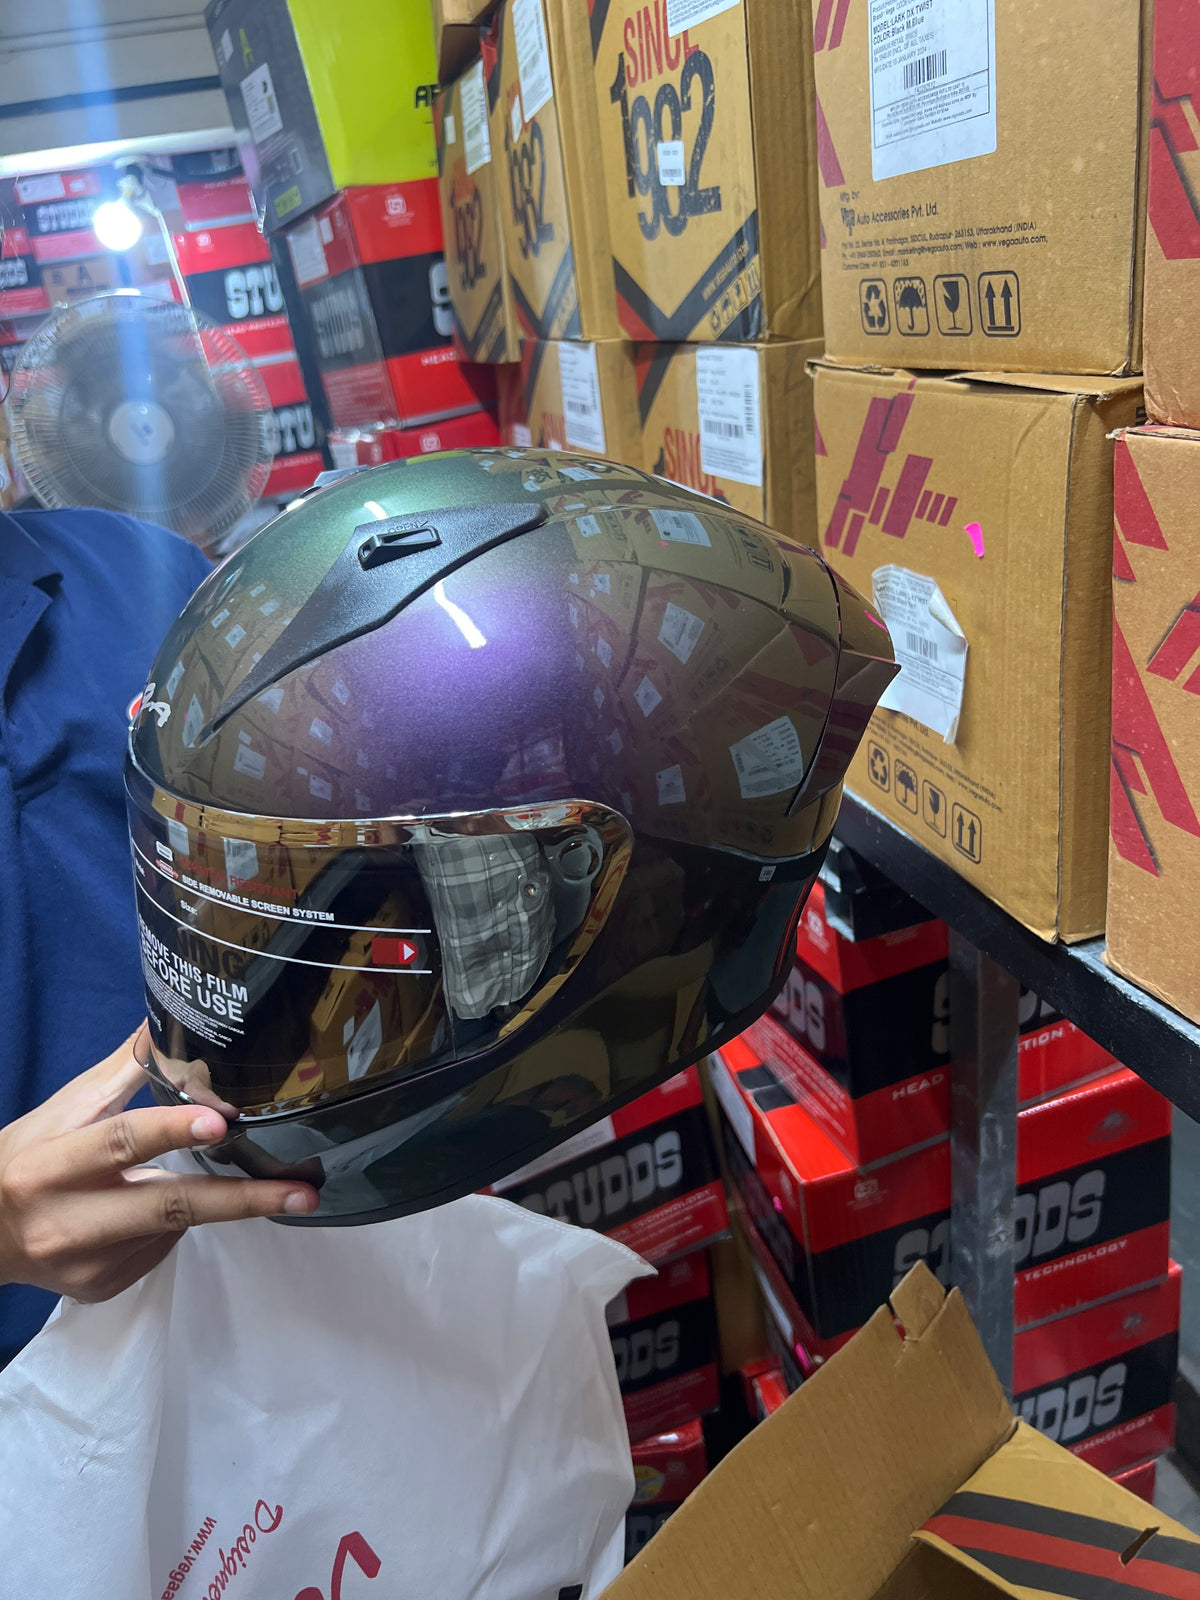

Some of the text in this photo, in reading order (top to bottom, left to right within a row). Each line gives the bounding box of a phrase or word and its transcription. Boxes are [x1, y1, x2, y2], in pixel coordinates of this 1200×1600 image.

[610, 50, 722, 241] 1982
[857, 212, 870, 225] Auto
[871, 207, 910, 224] Accessories
[911, 203, 924, 218] Pvt.
[926, 202, 939, 217] Ltd.
[182, 874, 335, 922] SIDE REMOVABLE SCREEN SYSTEM
[171, 951, 203, 984] THIS
[206, 972, 249, 1003] FILM
[196, 984, 245, 1023] USE
[891, 1072, 944, 1101] HEAD
[1023, 1239, 1128, 1283] TECHNOLOGY
